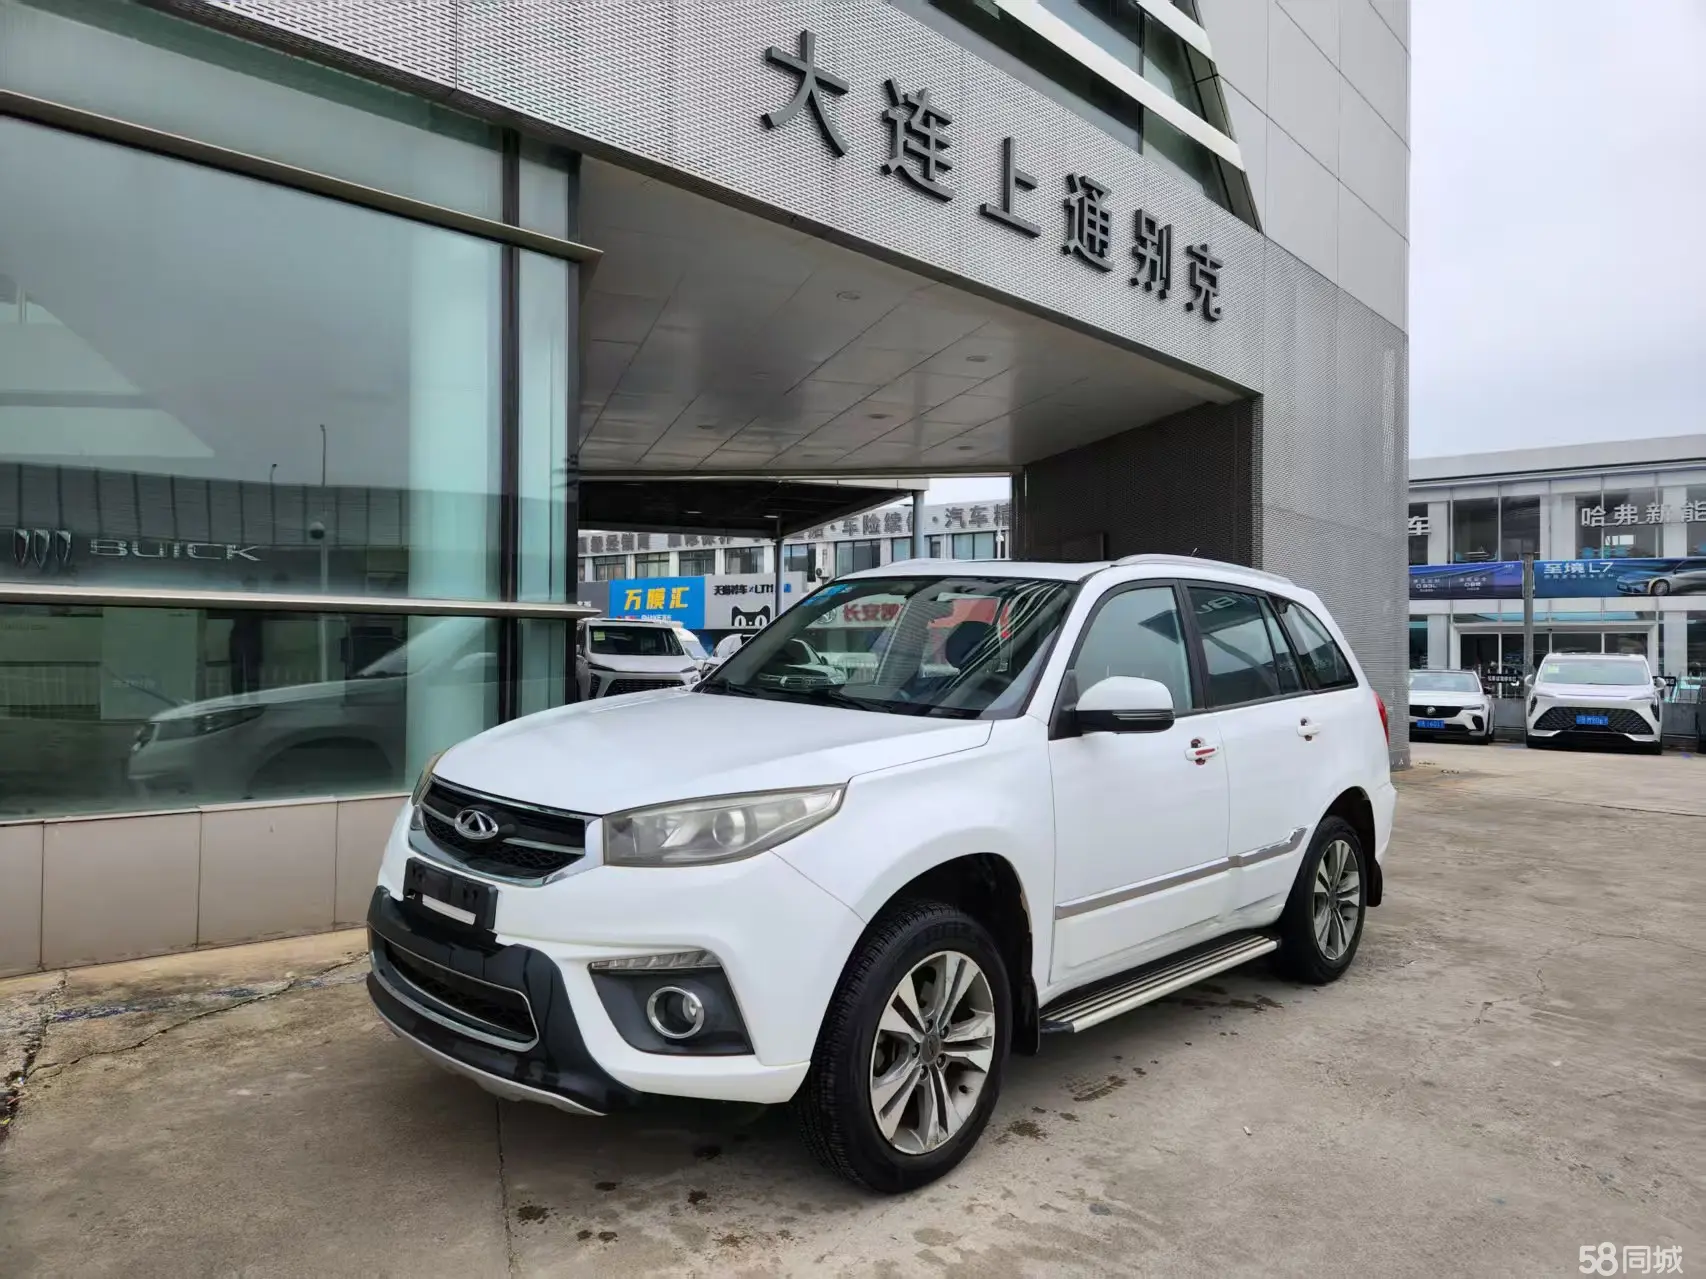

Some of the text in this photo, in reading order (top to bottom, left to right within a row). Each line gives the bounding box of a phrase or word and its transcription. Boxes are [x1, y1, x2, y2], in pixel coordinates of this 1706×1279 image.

[760, 29, 1224, 321] 大连上通别克
[90, 539, 261, 561] BUICK
